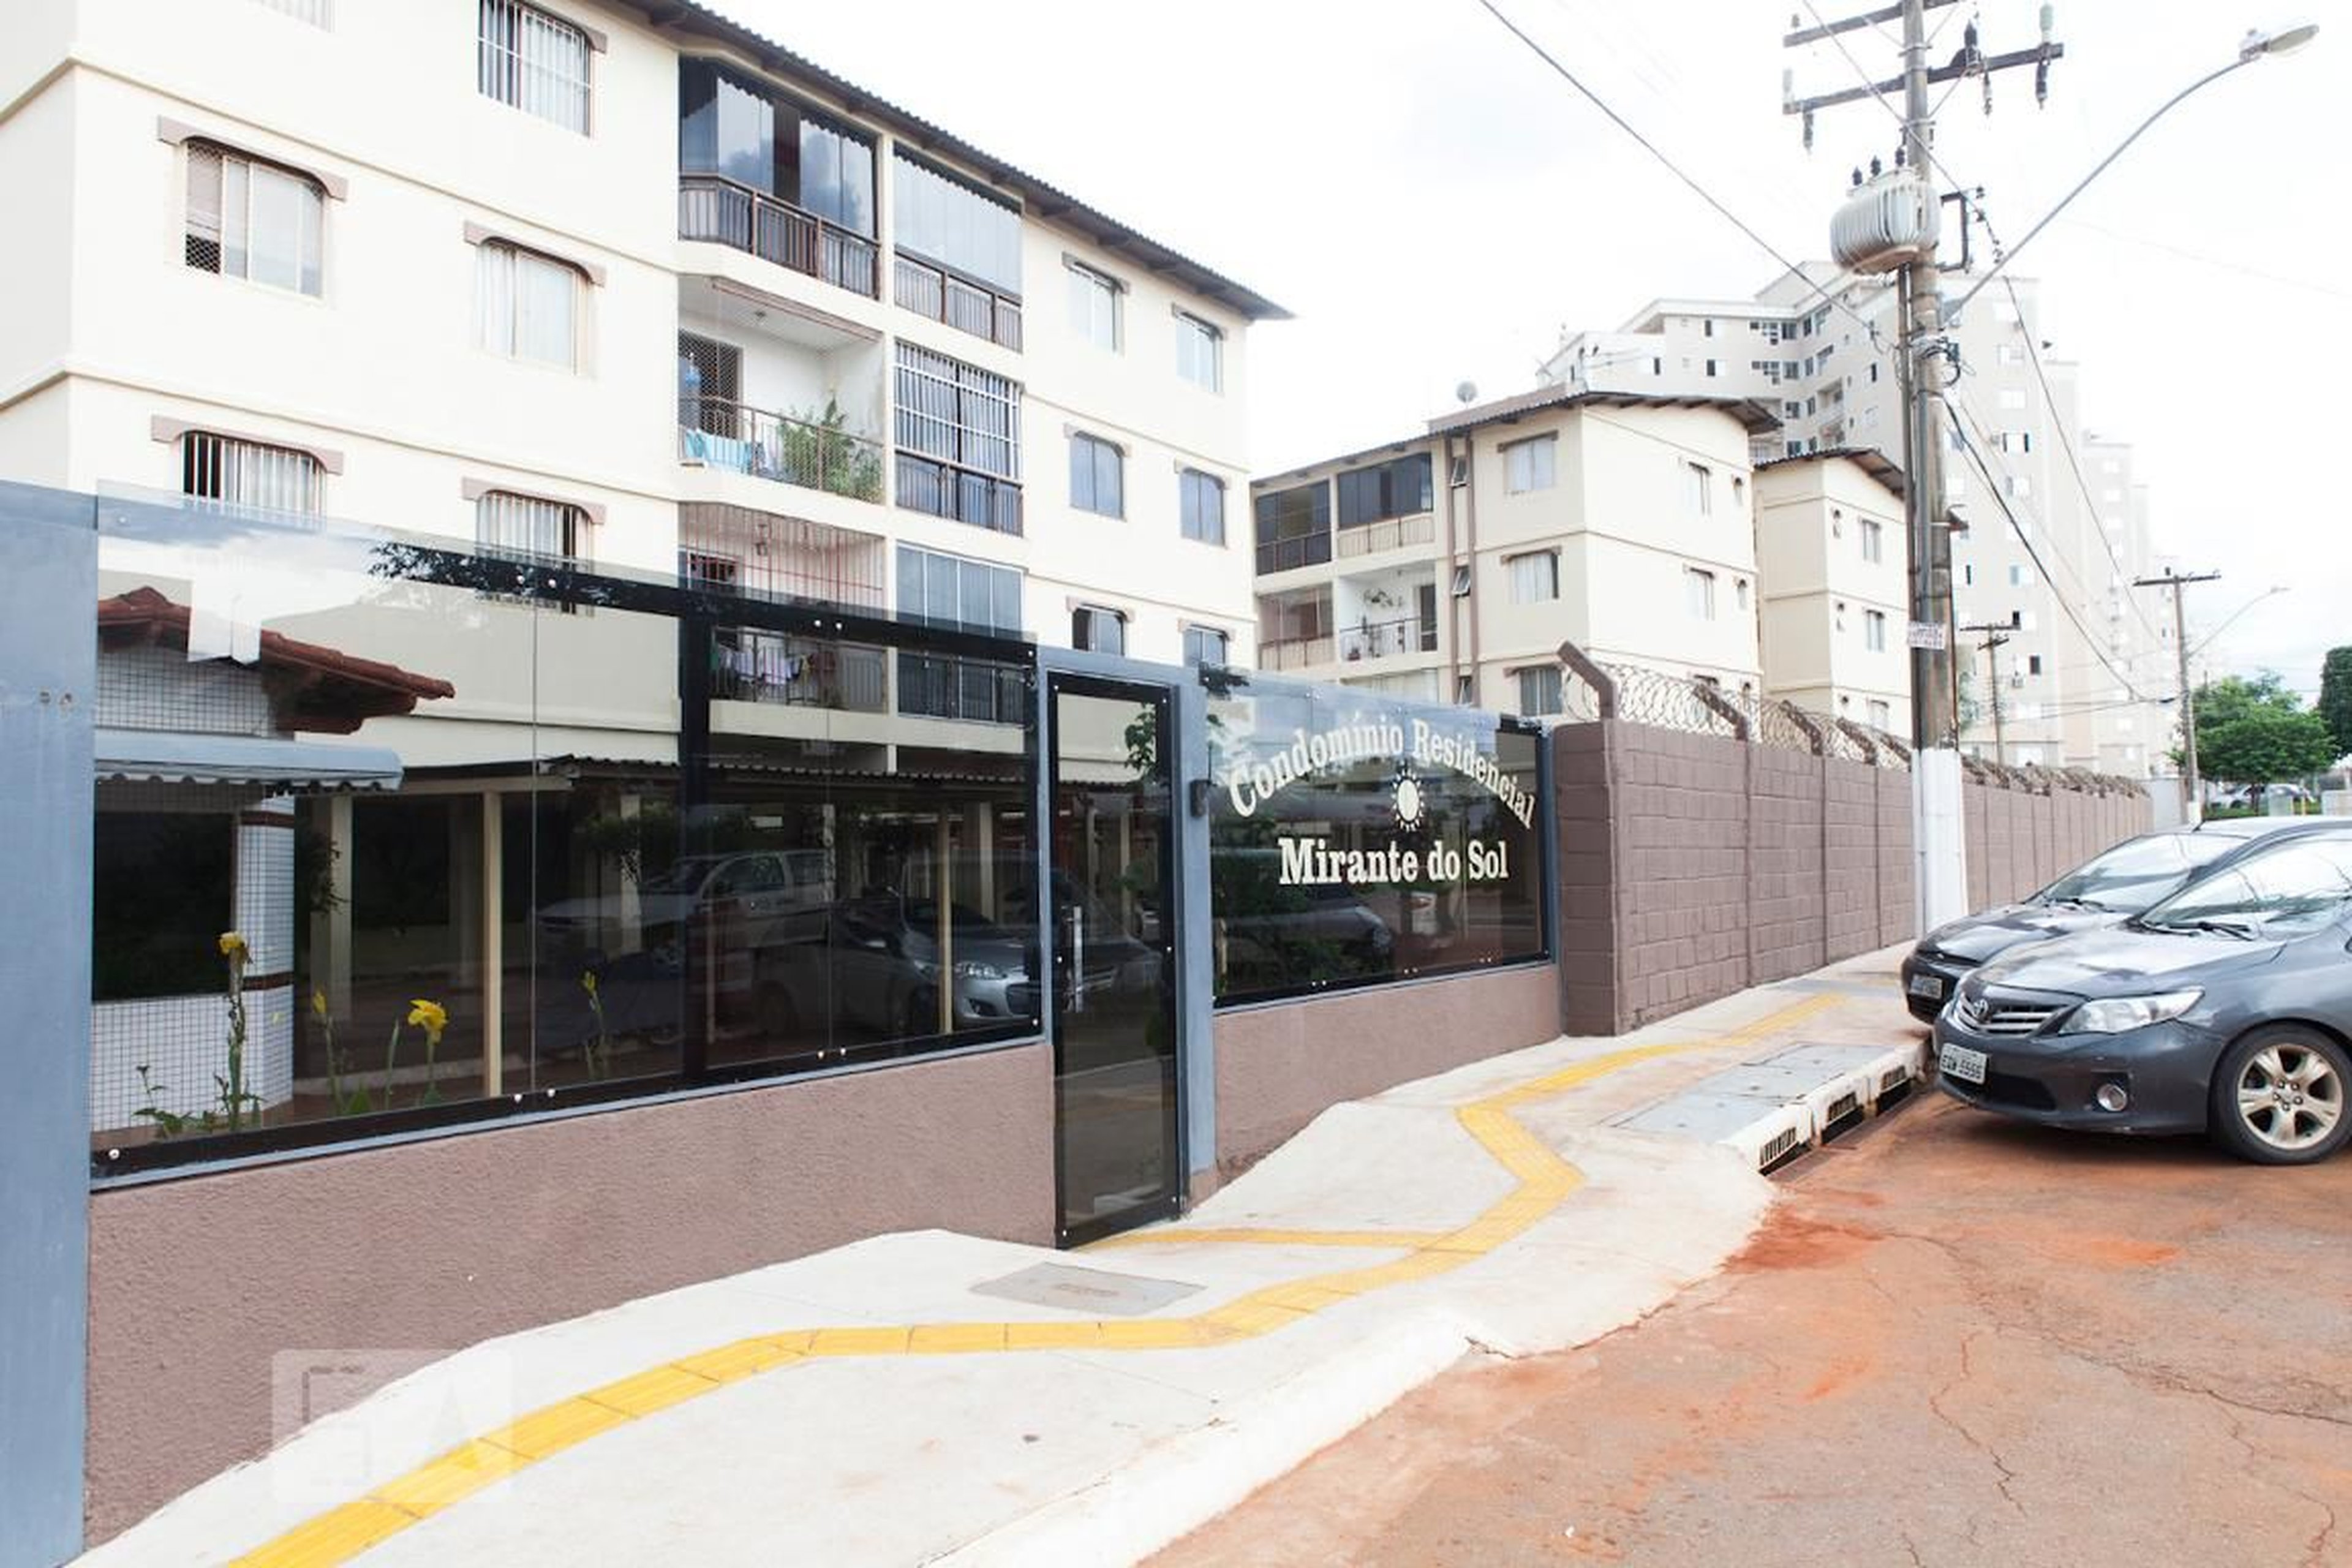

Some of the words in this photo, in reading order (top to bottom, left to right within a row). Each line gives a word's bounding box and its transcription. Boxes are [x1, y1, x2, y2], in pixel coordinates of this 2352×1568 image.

[1229, 710, 1404, 818] Condomínio
[1412, 718, 1536, 829] Residencial
[1277, 837, 1419, 884] Mirante
[1427, 840, 1461, 882] do
[1468, 839, 1509, 880] Sol
